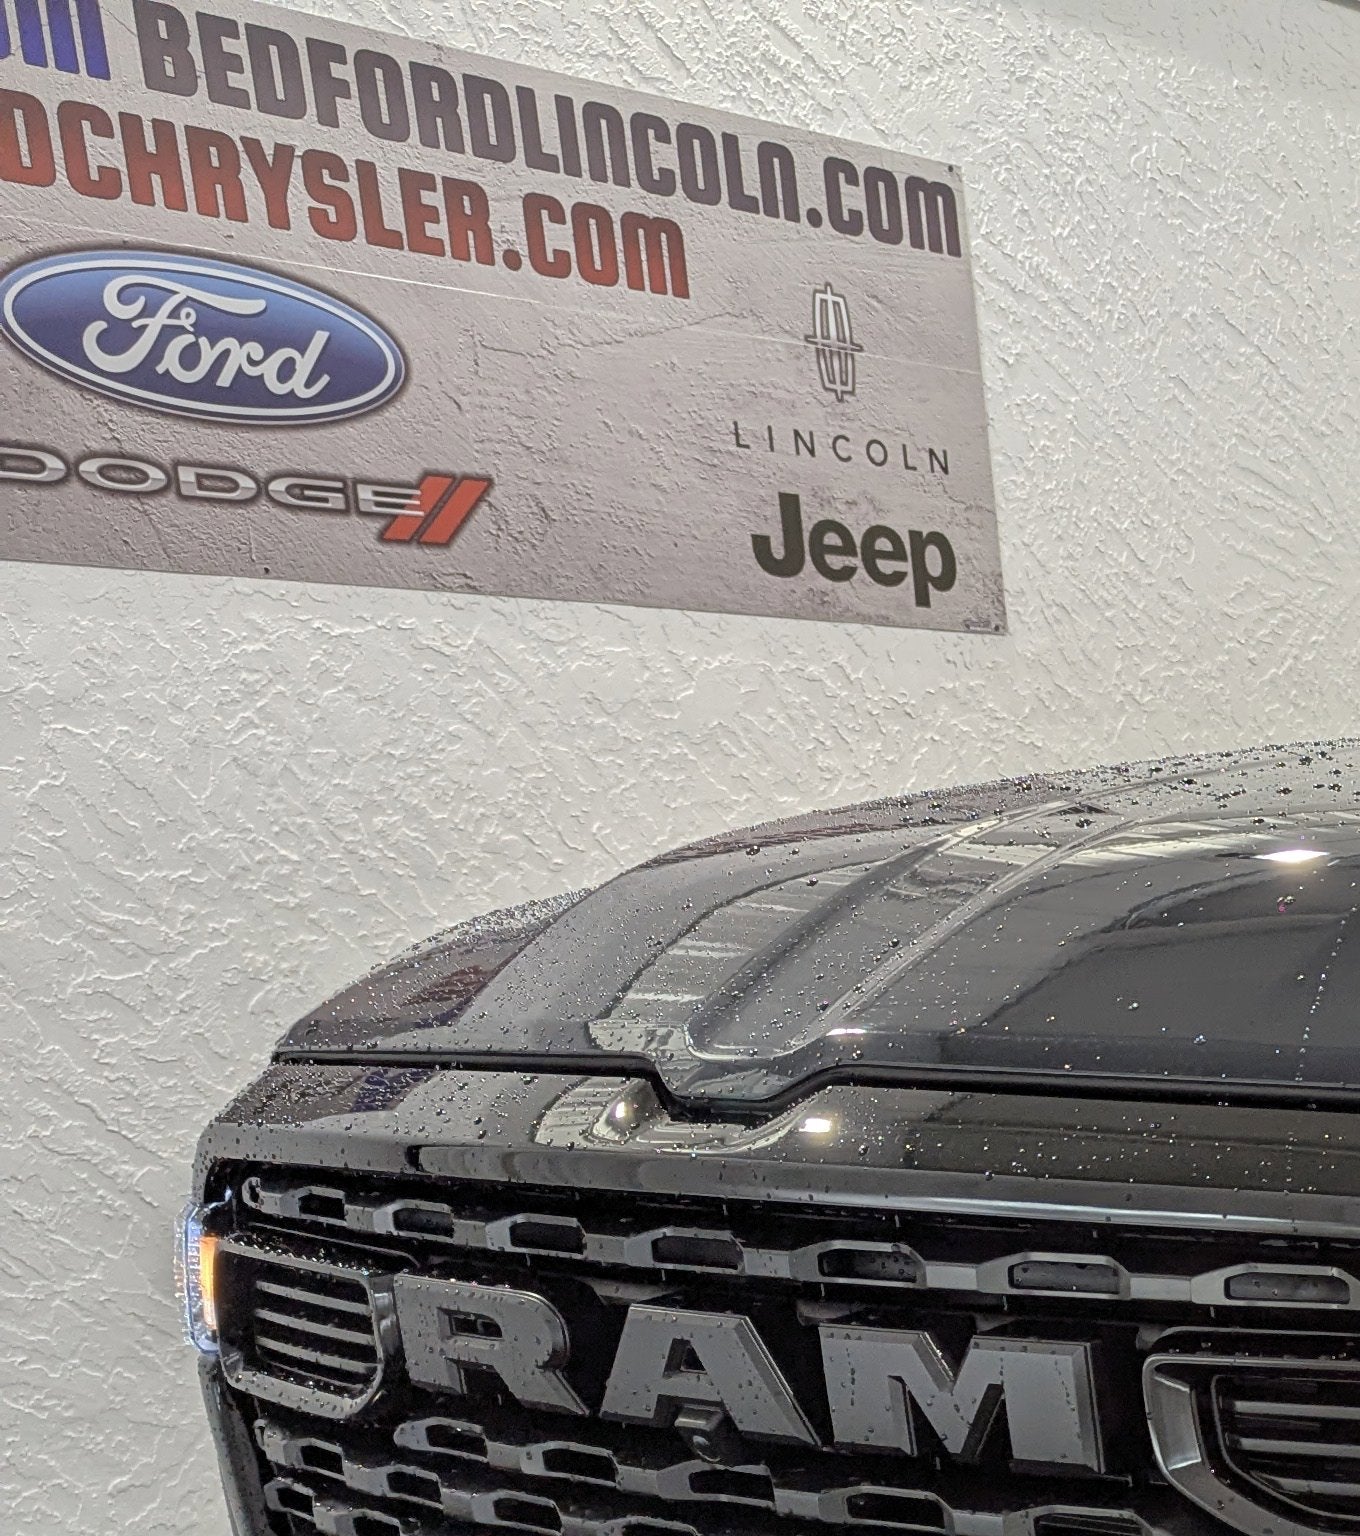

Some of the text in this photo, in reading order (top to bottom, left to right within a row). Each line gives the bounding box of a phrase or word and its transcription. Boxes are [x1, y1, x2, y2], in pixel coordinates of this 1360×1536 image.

[82, 273, 332, 399] Ford
[0, 447, 426, 518] DODGE
[733, 421, 950, 476] LINCOLN
[751, 491, 957, 608] Jeep
[394, 1272, 1107, 1475] RAM
